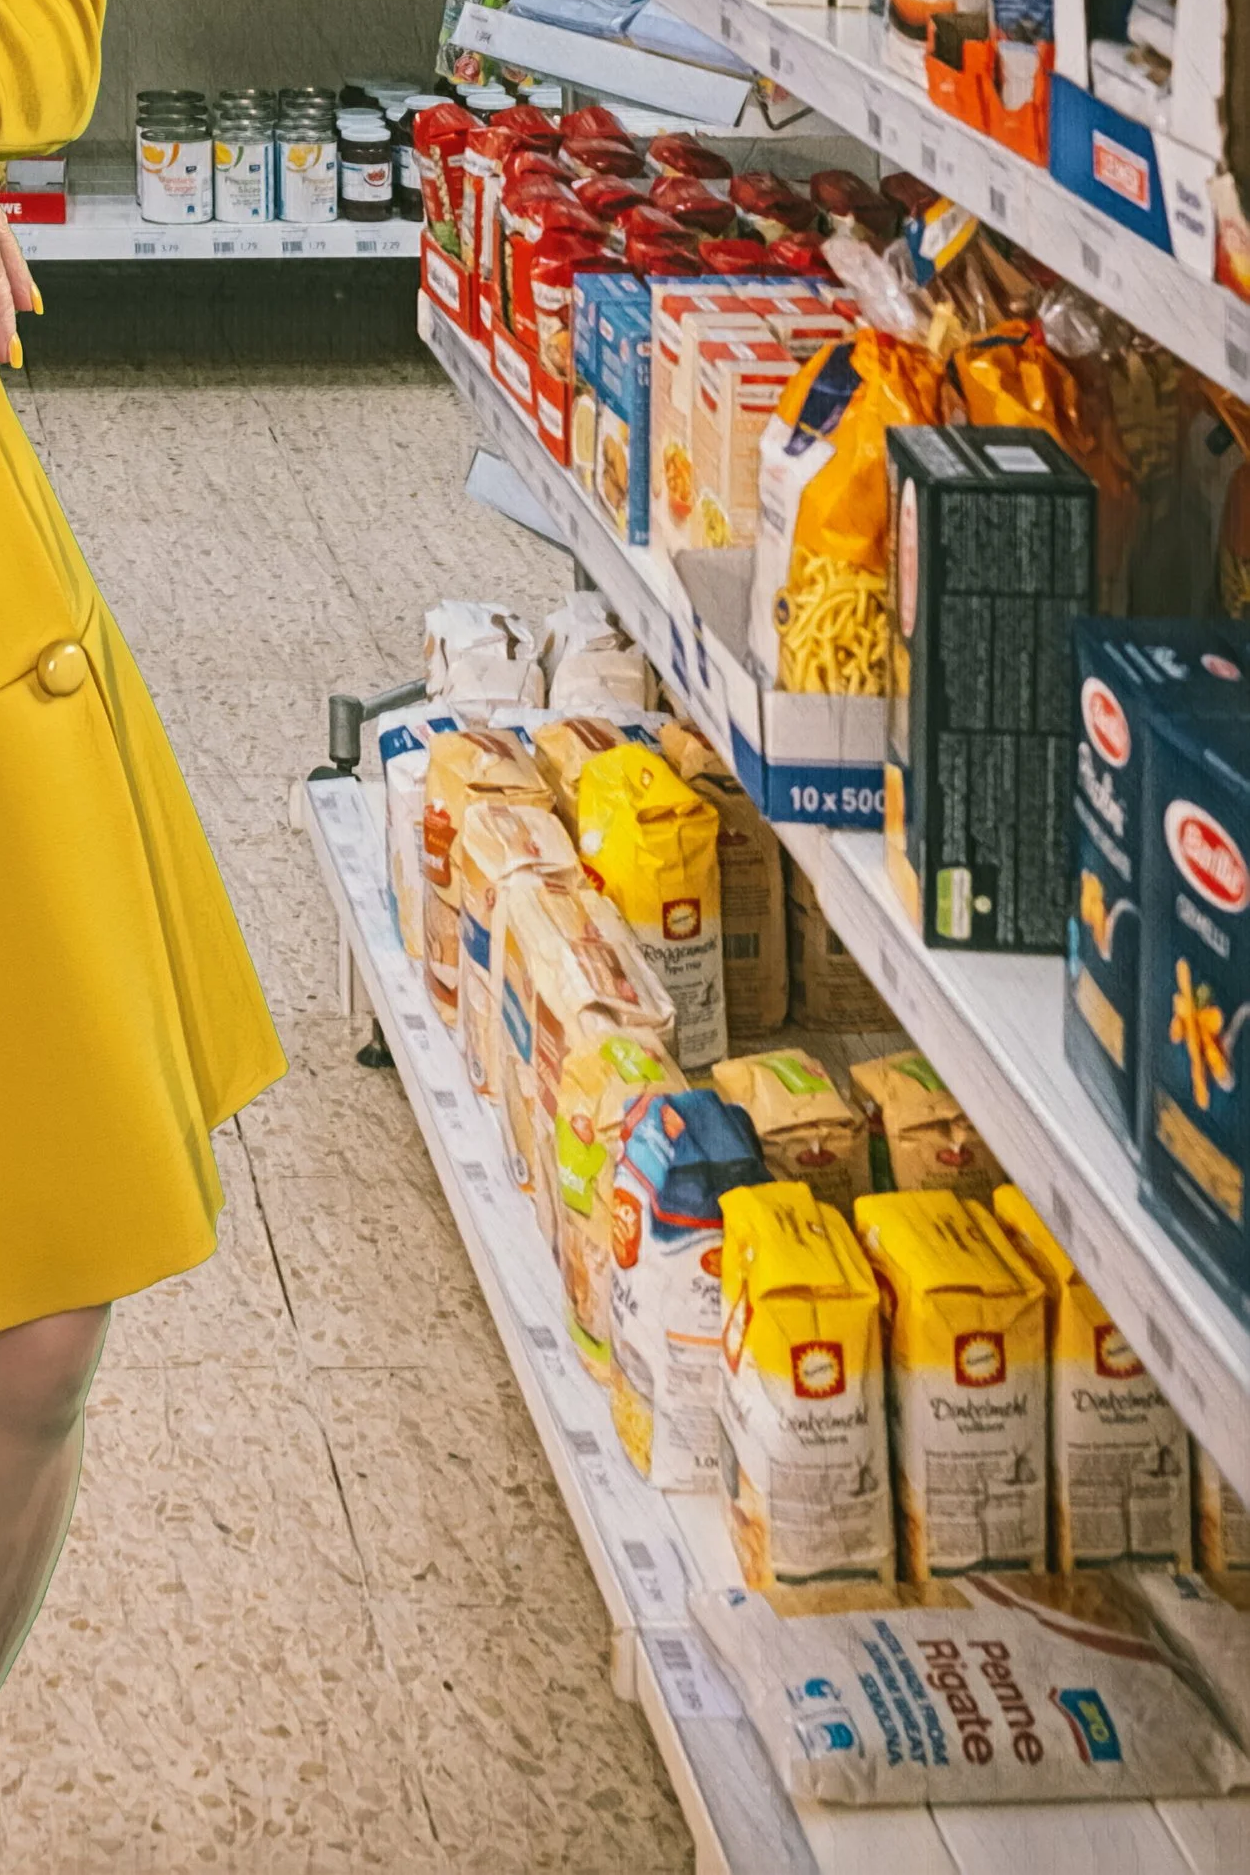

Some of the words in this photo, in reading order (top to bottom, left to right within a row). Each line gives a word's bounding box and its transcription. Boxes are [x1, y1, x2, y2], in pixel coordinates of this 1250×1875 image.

[0, 202, 23, 215] WE
[790, 785, 819, 813] 10
[822, 792, 837, 813] x
[914, 1639, 995, 1767] Rigate
[967, 1639, 1045, 1767] Penne
